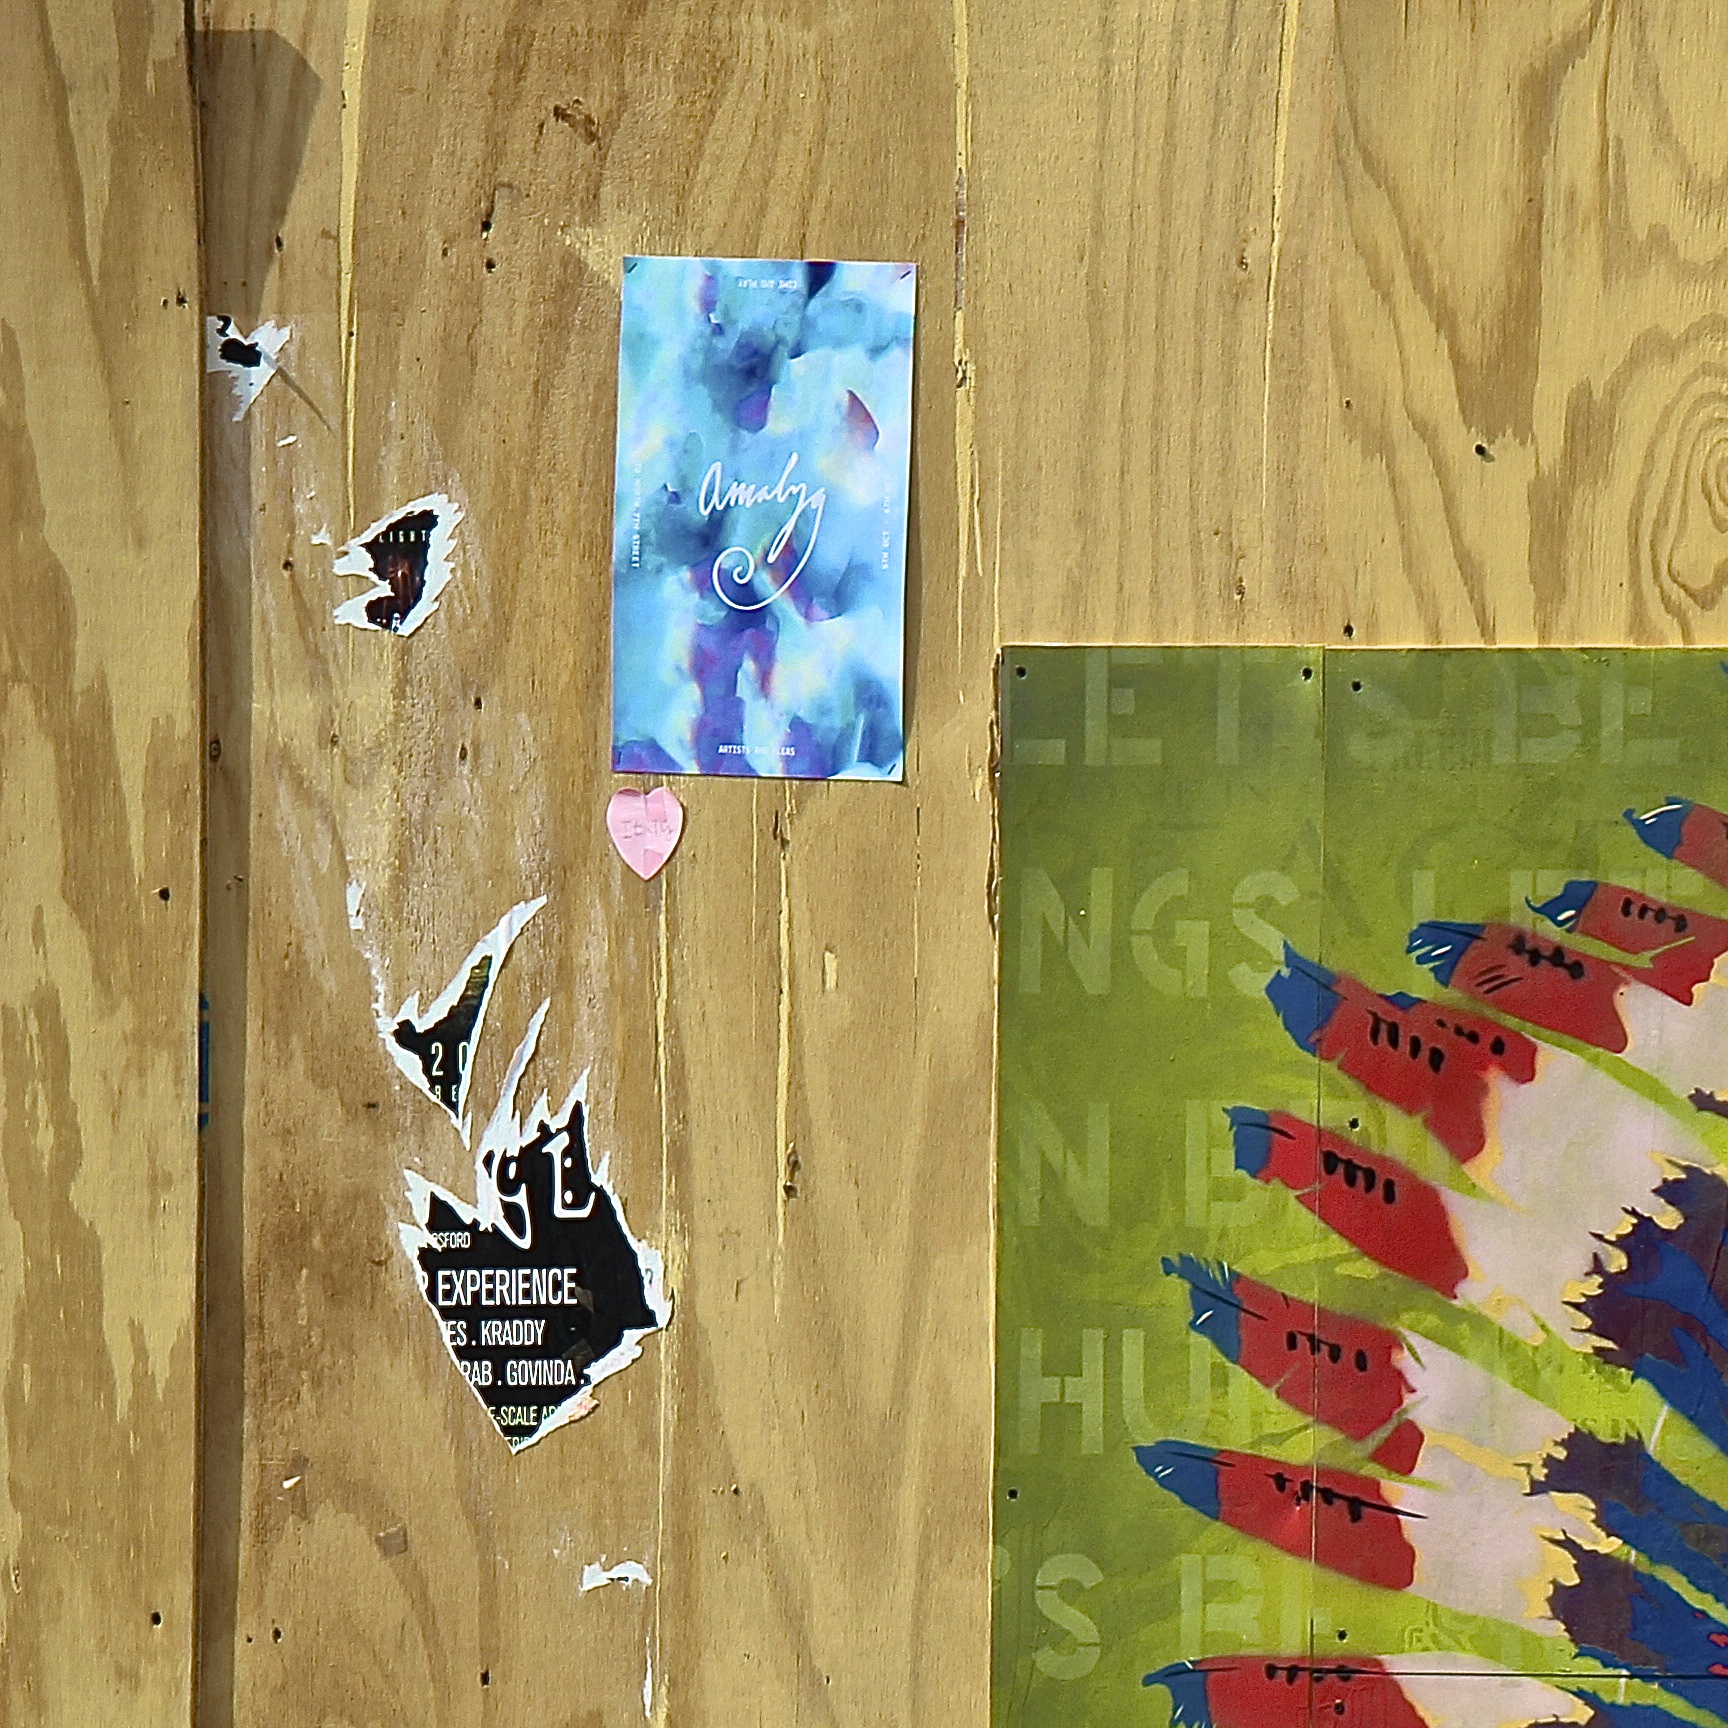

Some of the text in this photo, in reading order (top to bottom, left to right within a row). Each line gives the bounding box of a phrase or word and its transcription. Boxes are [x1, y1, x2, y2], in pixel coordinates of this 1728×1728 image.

[718, 744, 750, 754] ARTISTS
[436, 1267, 578, 1307] EXPERIENCE
[480, 1319, 546, 1347] KRADDY
[506, 1359, 576, 1387] GOVINDA
